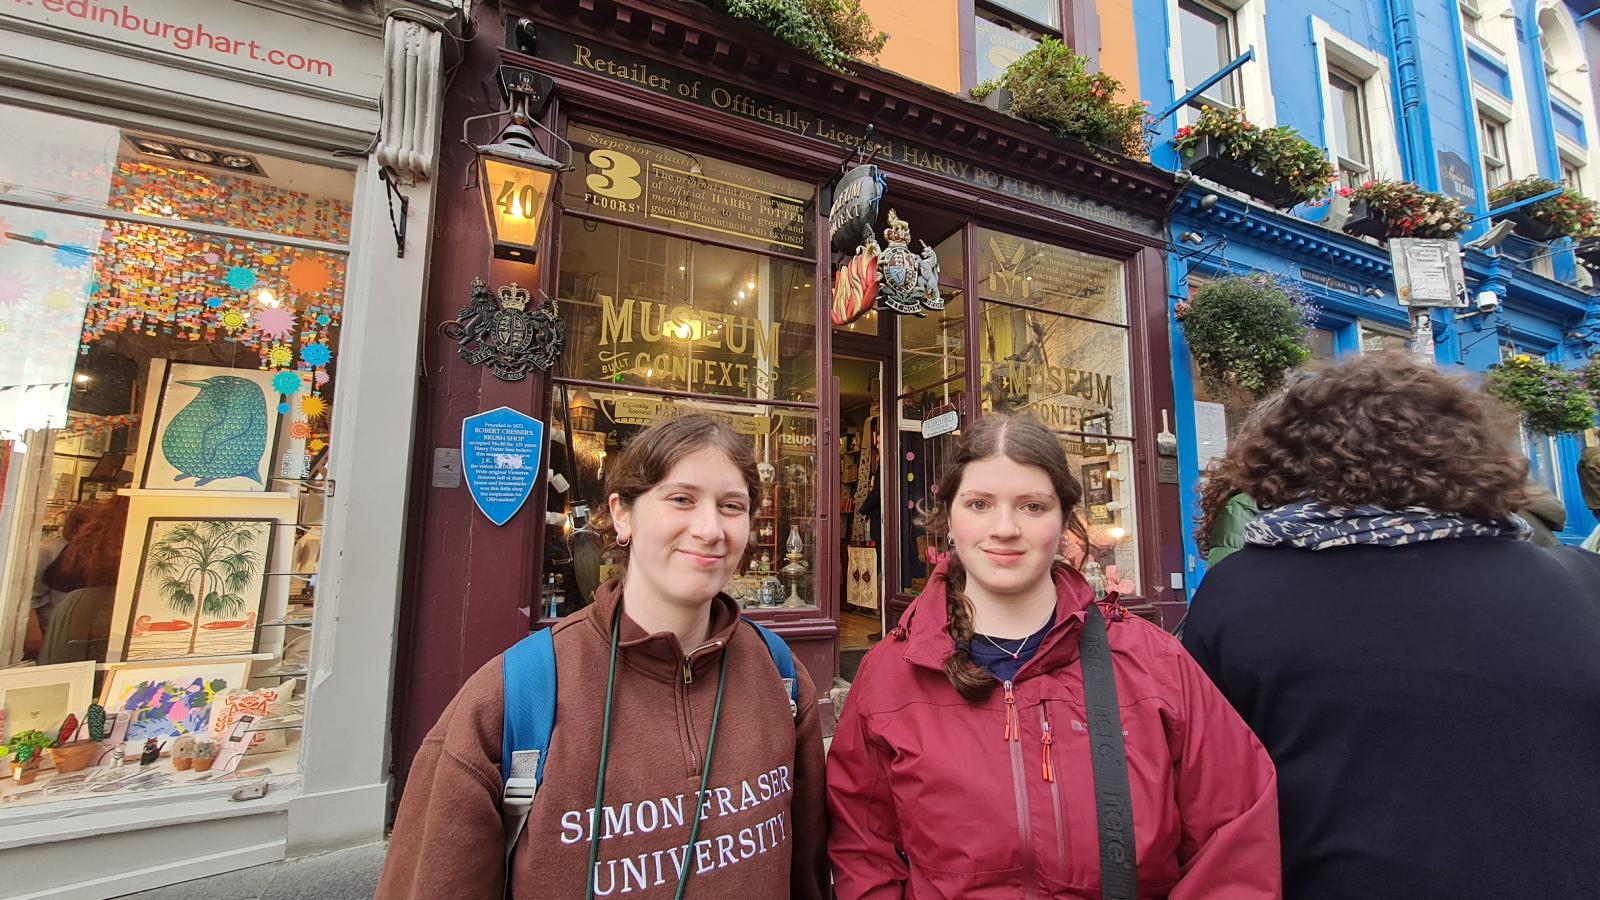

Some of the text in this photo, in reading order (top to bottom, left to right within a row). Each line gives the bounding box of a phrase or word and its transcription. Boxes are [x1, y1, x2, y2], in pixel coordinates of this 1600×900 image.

[573, 43, 671, 91] Retailer
[677, 81, 700, 99] of
[711, 87, 811, 136] Officially
[903, 144, 971, 179] HARRY
[974, 167, 1047, 202] POTTER
[1052, 190, 1133, 226] Merchandise
[588, 133, 652, 156] Superior
[586, 149, 642, 200] 3
[652, 168, 804, 213] The original and best purveyors
[496, 180, 539, 219] 40
[584, 193, 641, 213] FLOORS!
[652, 181, 804, 223] of official HARRY POTTER
[652, 193, 804, 234] merchandise to the great and
[651, 205, 676, 216] good
[680, 211, 691, 219] of
[769, 230, 804, 245] BEYOND!
[599, 294, 782, 369] MUSEUM
[601, 358, 629, 374] BUILT
[635, 352, 749, 389] CONTEXT
[1008, 360, 1113, 411] MUSEUM
[695, 765, 791, 821] FRASER
[560, 794, 685, 844] SIMON
[593, 811, 786, 896] UNIVERSITY
